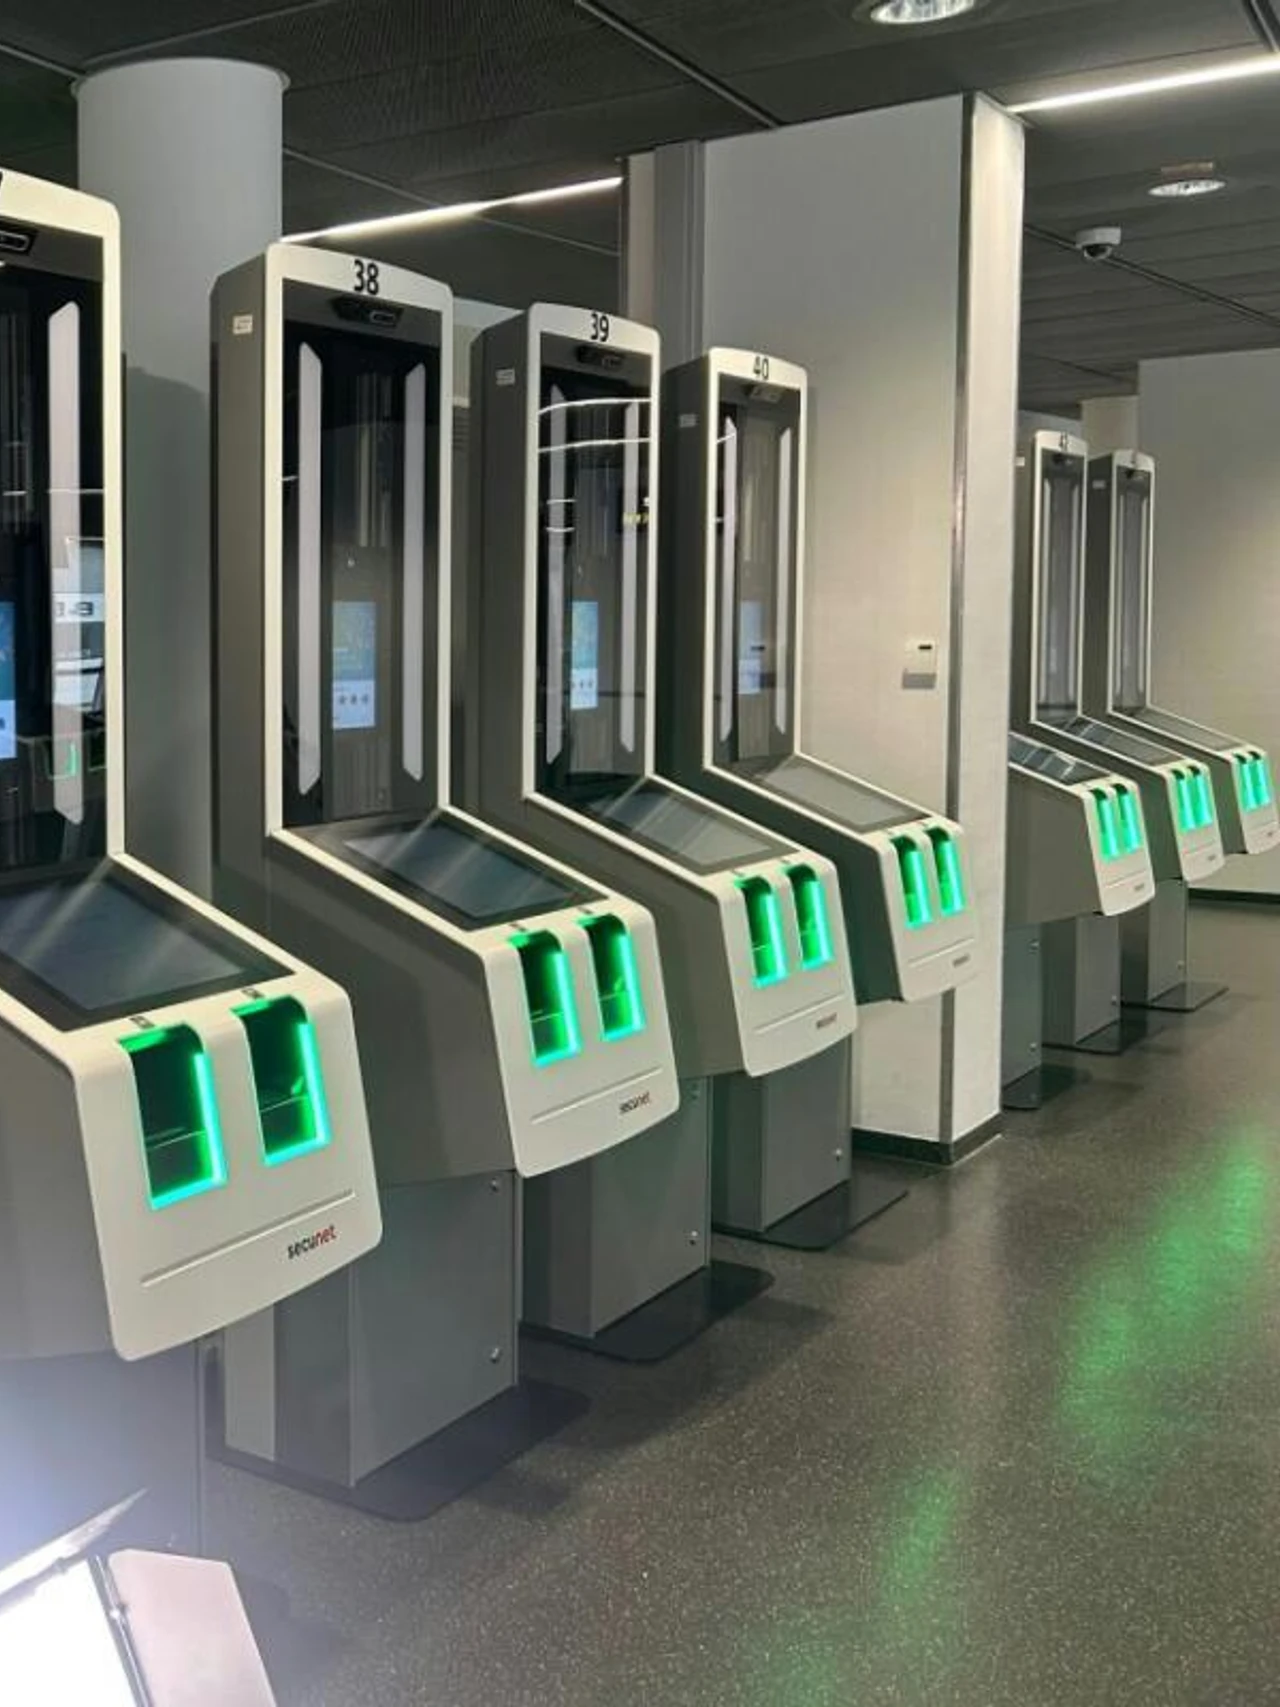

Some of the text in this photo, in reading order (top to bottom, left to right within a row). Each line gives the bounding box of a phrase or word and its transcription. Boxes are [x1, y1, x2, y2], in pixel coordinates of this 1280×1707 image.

[354, 259, 379, 295] 38
[591, 312, 609, 342] 39
[753, 356, 769, 380] 40
[287, 1224, 337, 1260] secunet
